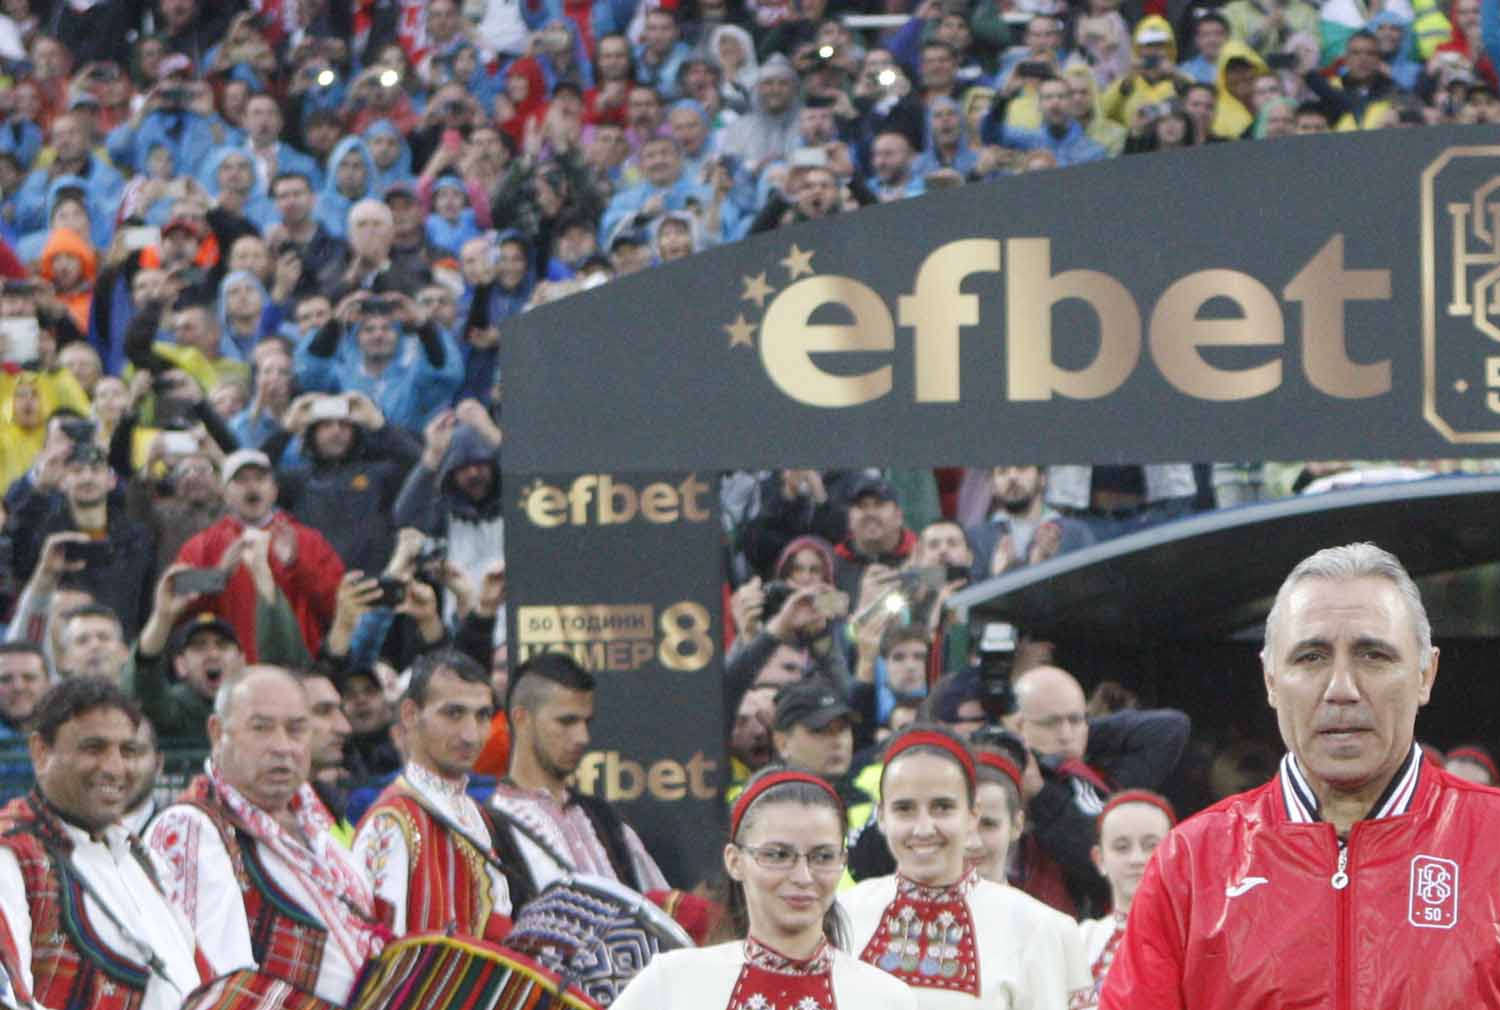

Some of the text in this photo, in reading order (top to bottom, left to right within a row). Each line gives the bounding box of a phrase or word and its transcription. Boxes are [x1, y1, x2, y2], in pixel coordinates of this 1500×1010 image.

[759, 234, 1393, 407] efbet
[527, 472, 711, 527] efbet
[528, 615, 553, 633] 50
[658, 601, 715, 673] 8
[569, 750, 717, 801] fbet
[1424, 907, 1442, 921] 50
